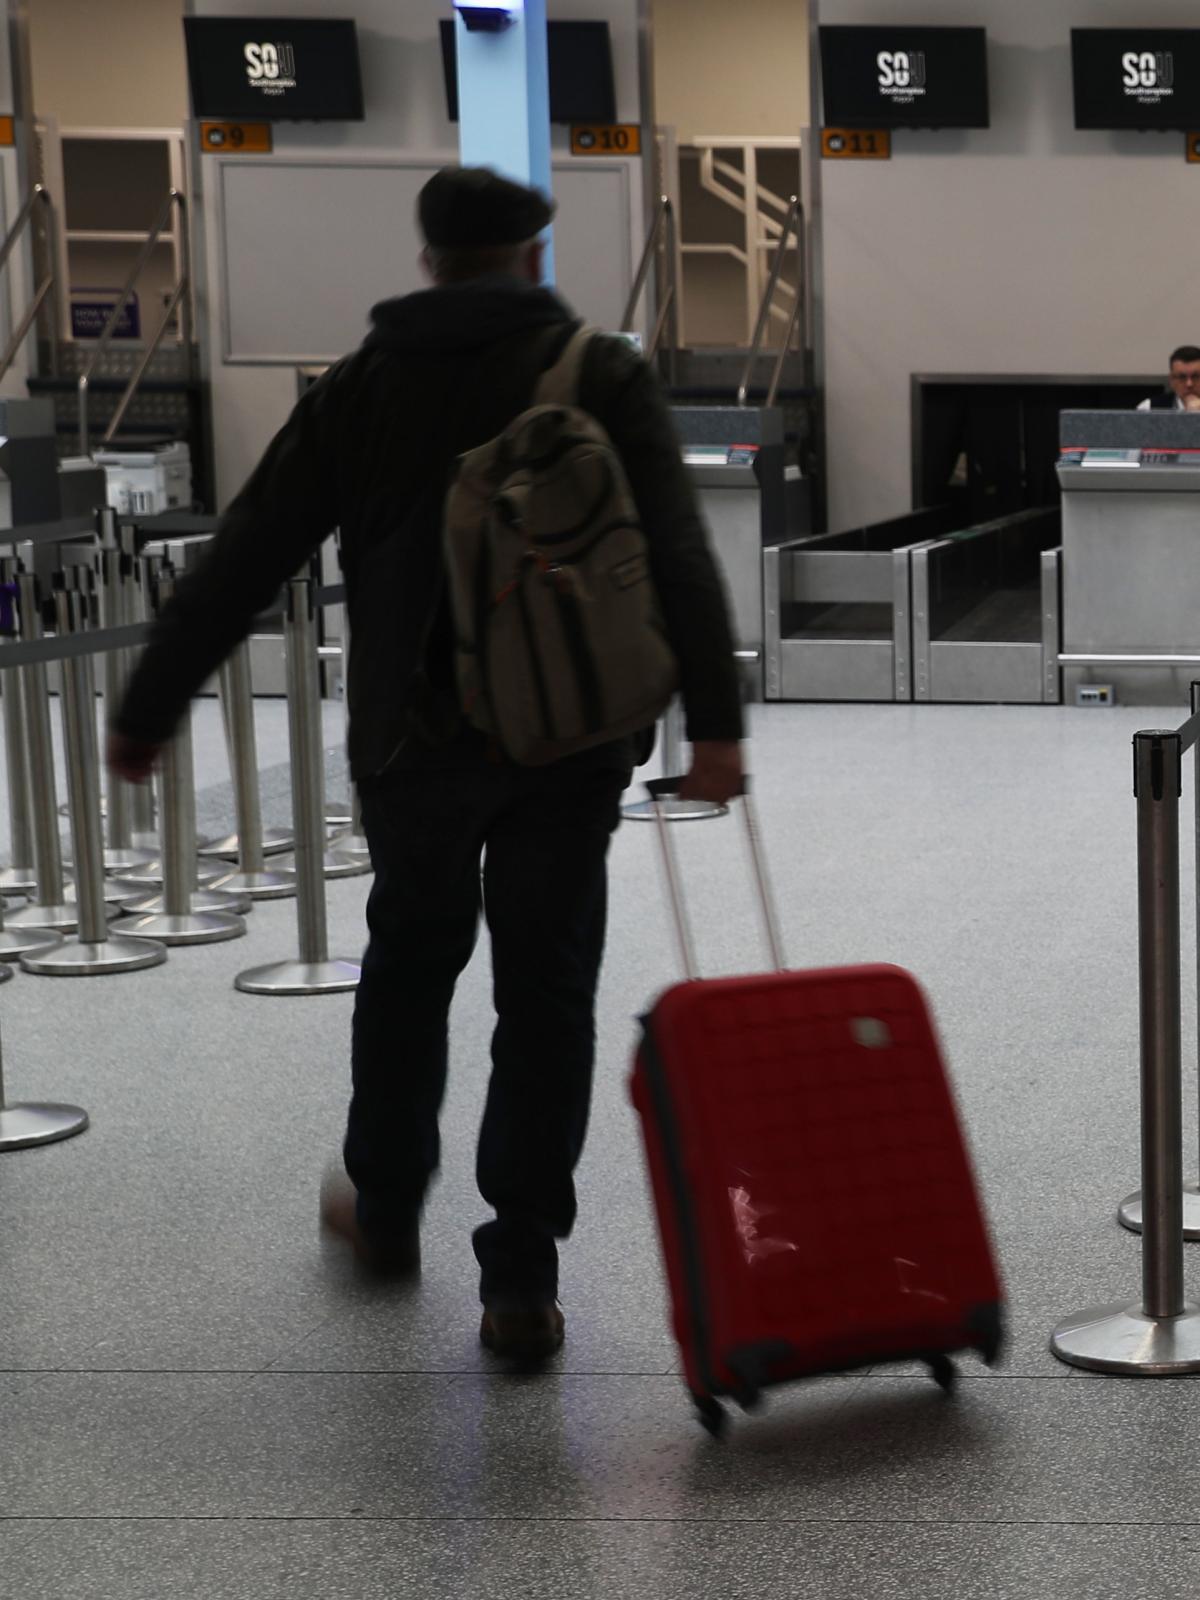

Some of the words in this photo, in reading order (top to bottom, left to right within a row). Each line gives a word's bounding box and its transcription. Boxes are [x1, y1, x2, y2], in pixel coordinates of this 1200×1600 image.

[229, 128, 244, 147] 9
[602, 130, 628, 150] 10
[851, 134, 878, 153] 11
